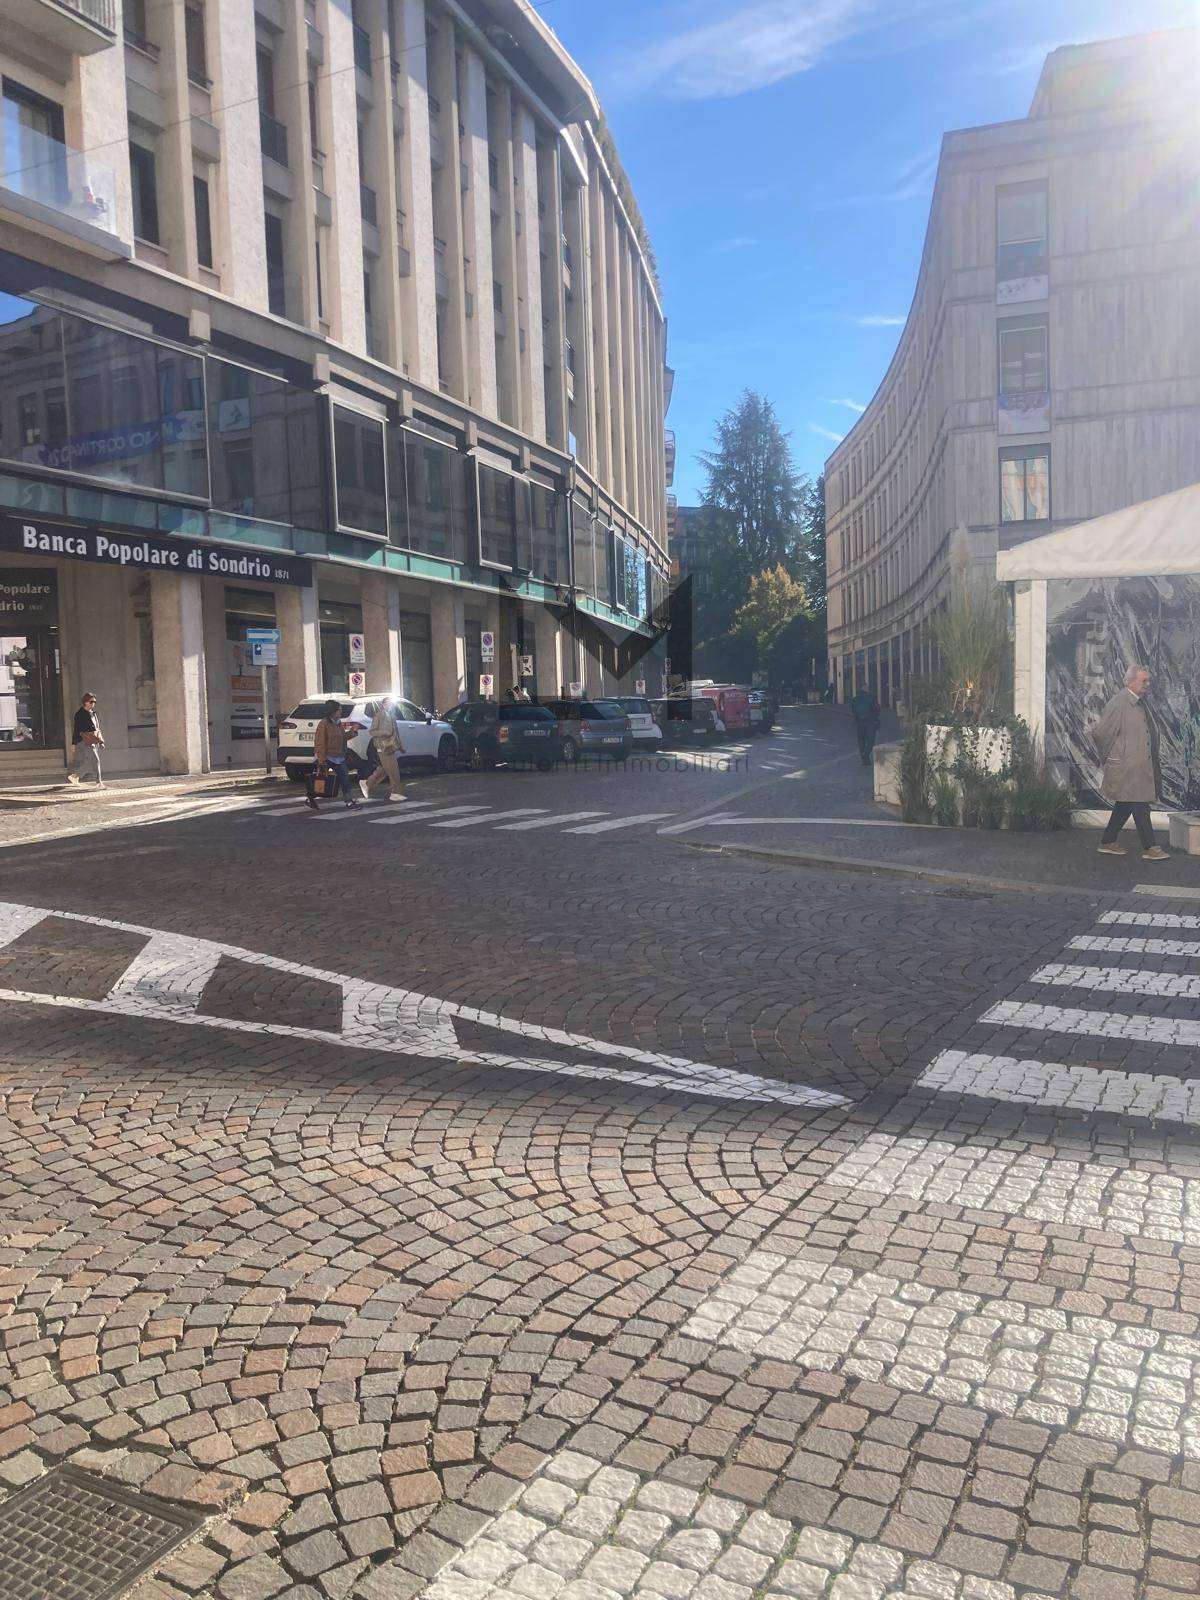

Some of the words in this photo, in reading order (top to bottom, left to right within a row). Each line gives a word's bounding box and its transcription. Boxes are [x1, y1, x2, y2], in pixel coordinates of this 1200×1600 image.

[23, 525, 87, 555] Banca
[96, 536, 180, 566] Popolare
[187, 549, 203, 569] di
[209, 552, 271, 577] Sondrio
[275, 569, 289, 580] 1871
[0, 600, 25, 611] drio
